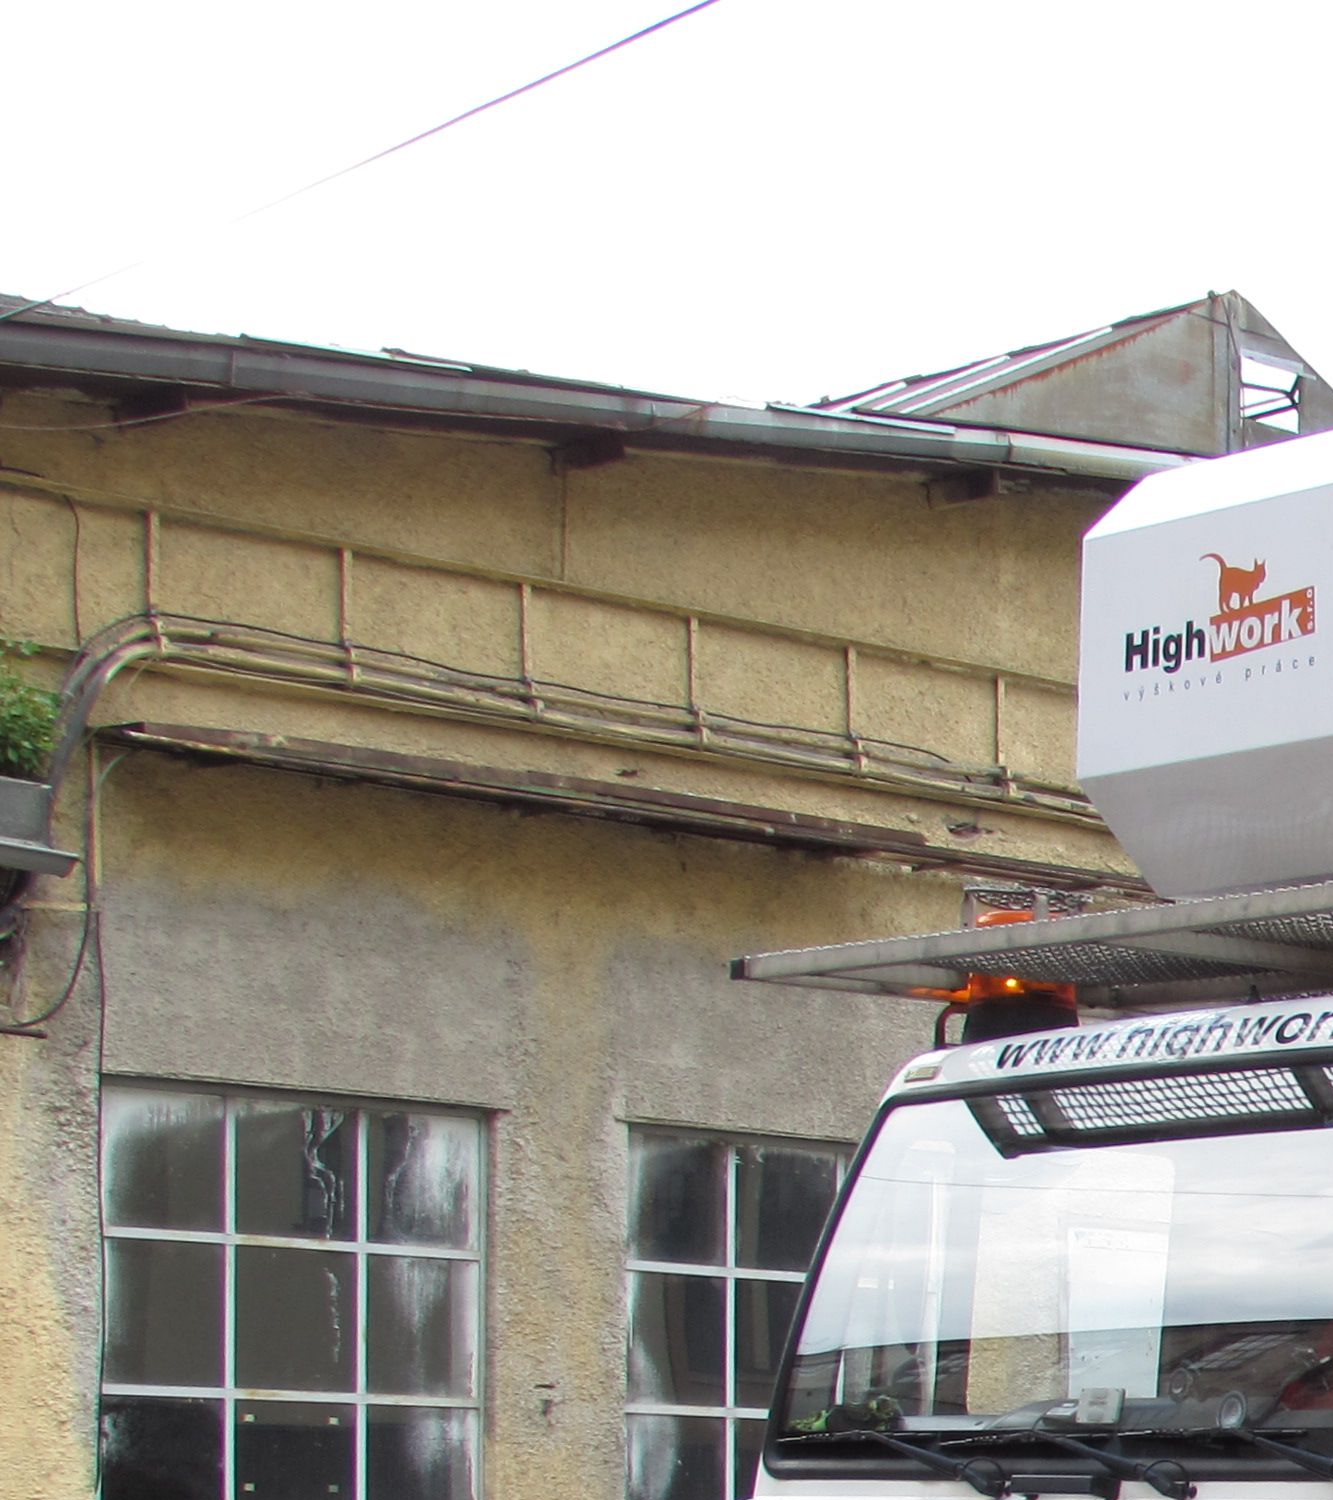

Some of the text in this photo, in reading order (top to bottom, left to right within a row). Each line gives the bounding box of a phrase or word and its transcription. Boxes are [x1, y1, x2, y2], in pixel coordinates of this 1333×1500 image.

[1124, 599, 1303, 674] Highwork
[1123, 655, 1316, 702] výškové práce
